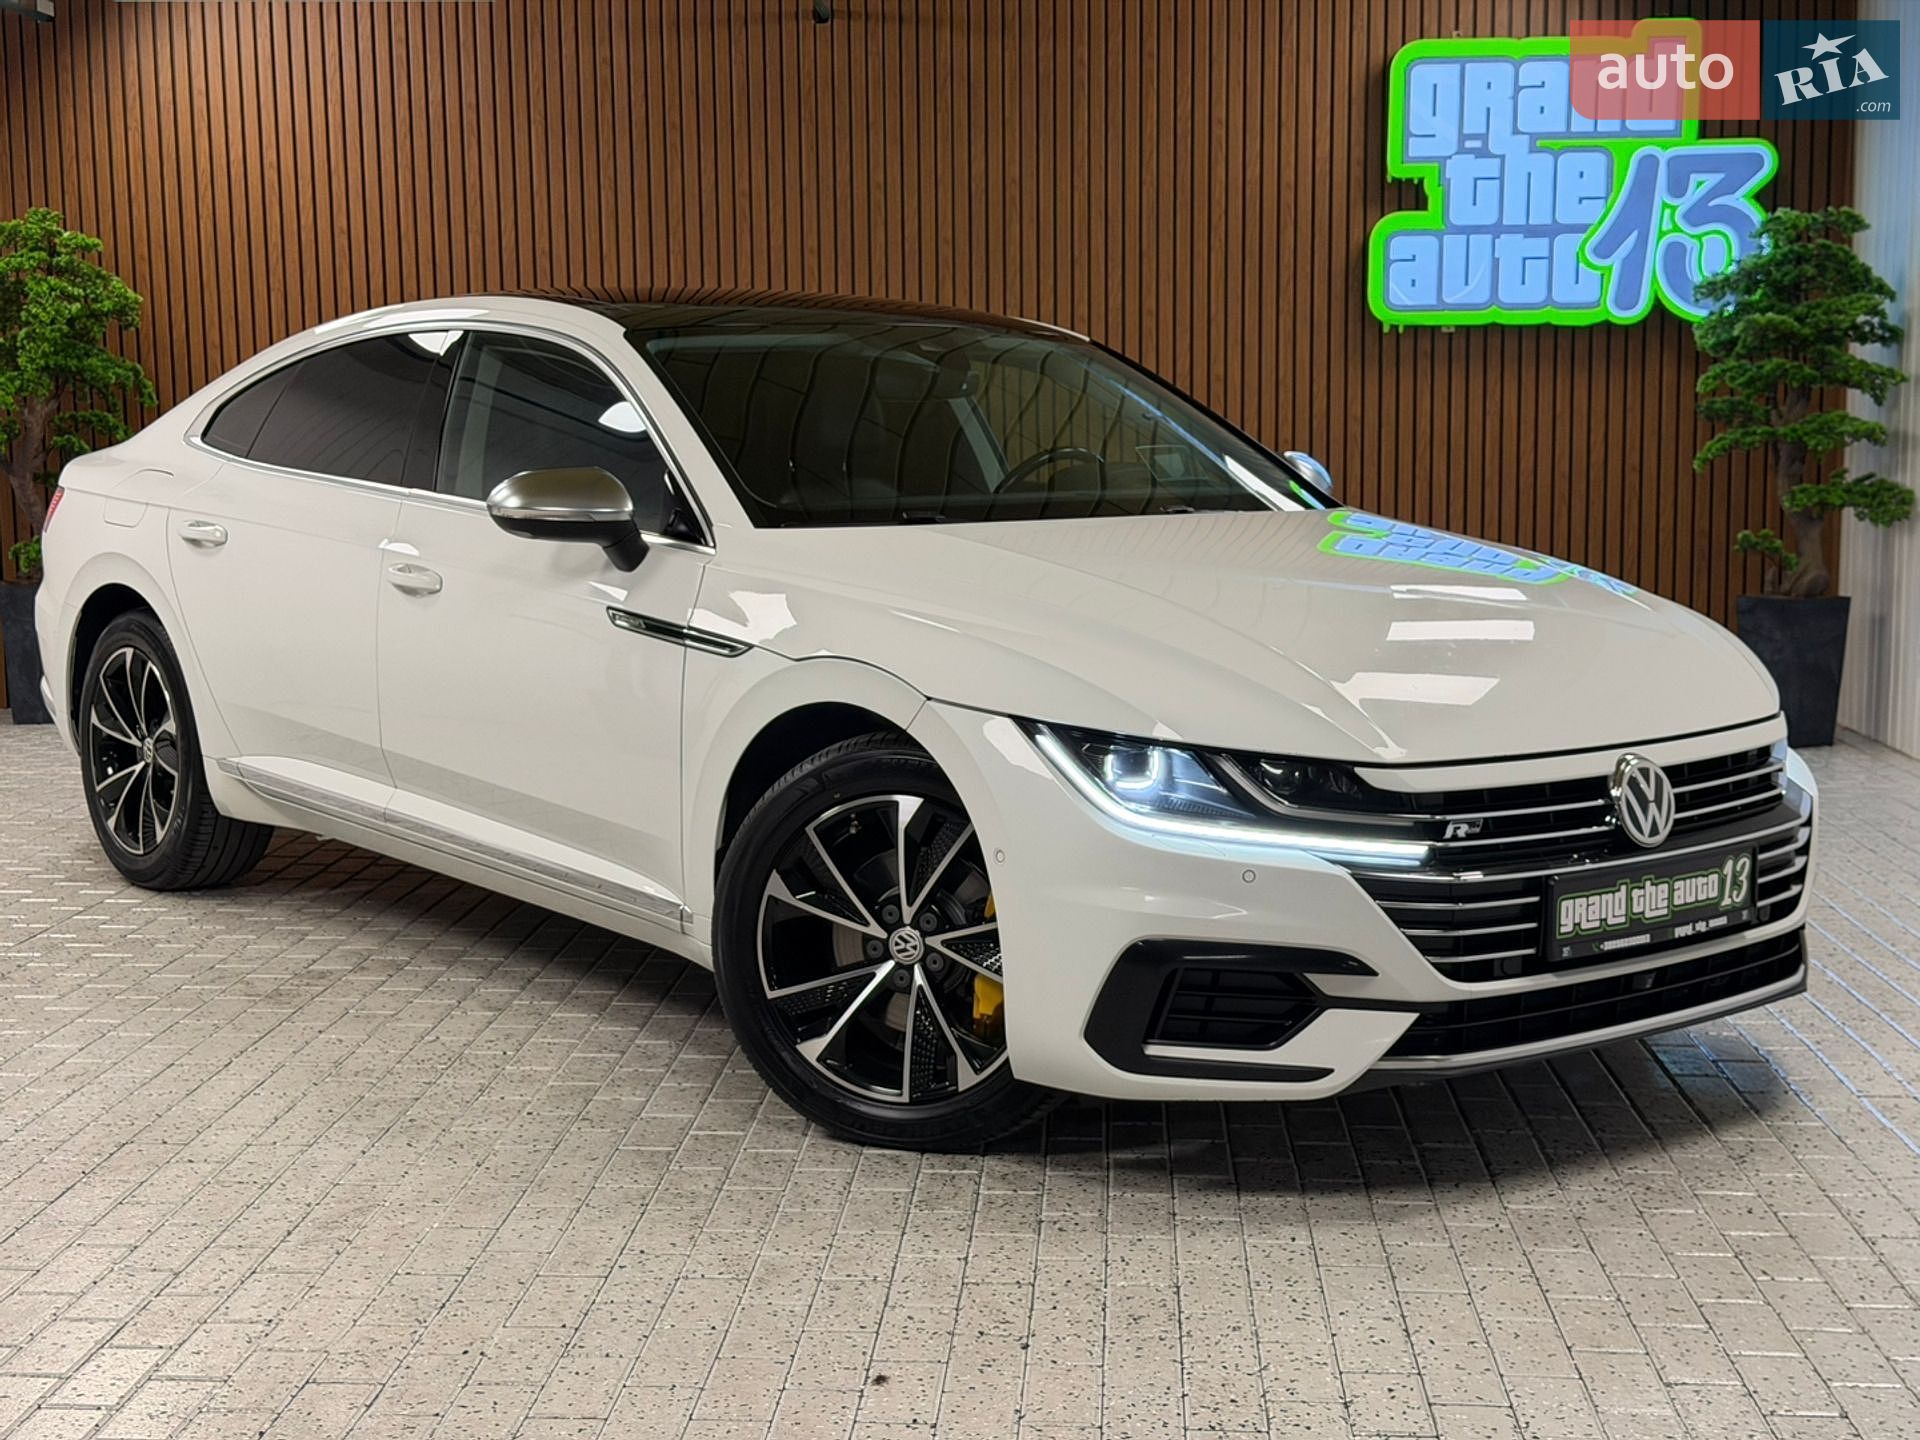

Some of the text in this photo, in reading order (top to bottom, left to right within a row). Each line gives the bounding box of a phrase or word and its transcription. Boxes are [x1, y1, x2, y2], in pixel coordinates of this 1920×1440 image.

[1446, 133, 1609, 227] the
[1388, 233, 1602, 307] auto
[1586, 147, 1768, 318] 13
[1631, 880, 1669, 918] the
[1673, 873, 1719, 906] auto
[1720, 856, 1750, 907] 13
